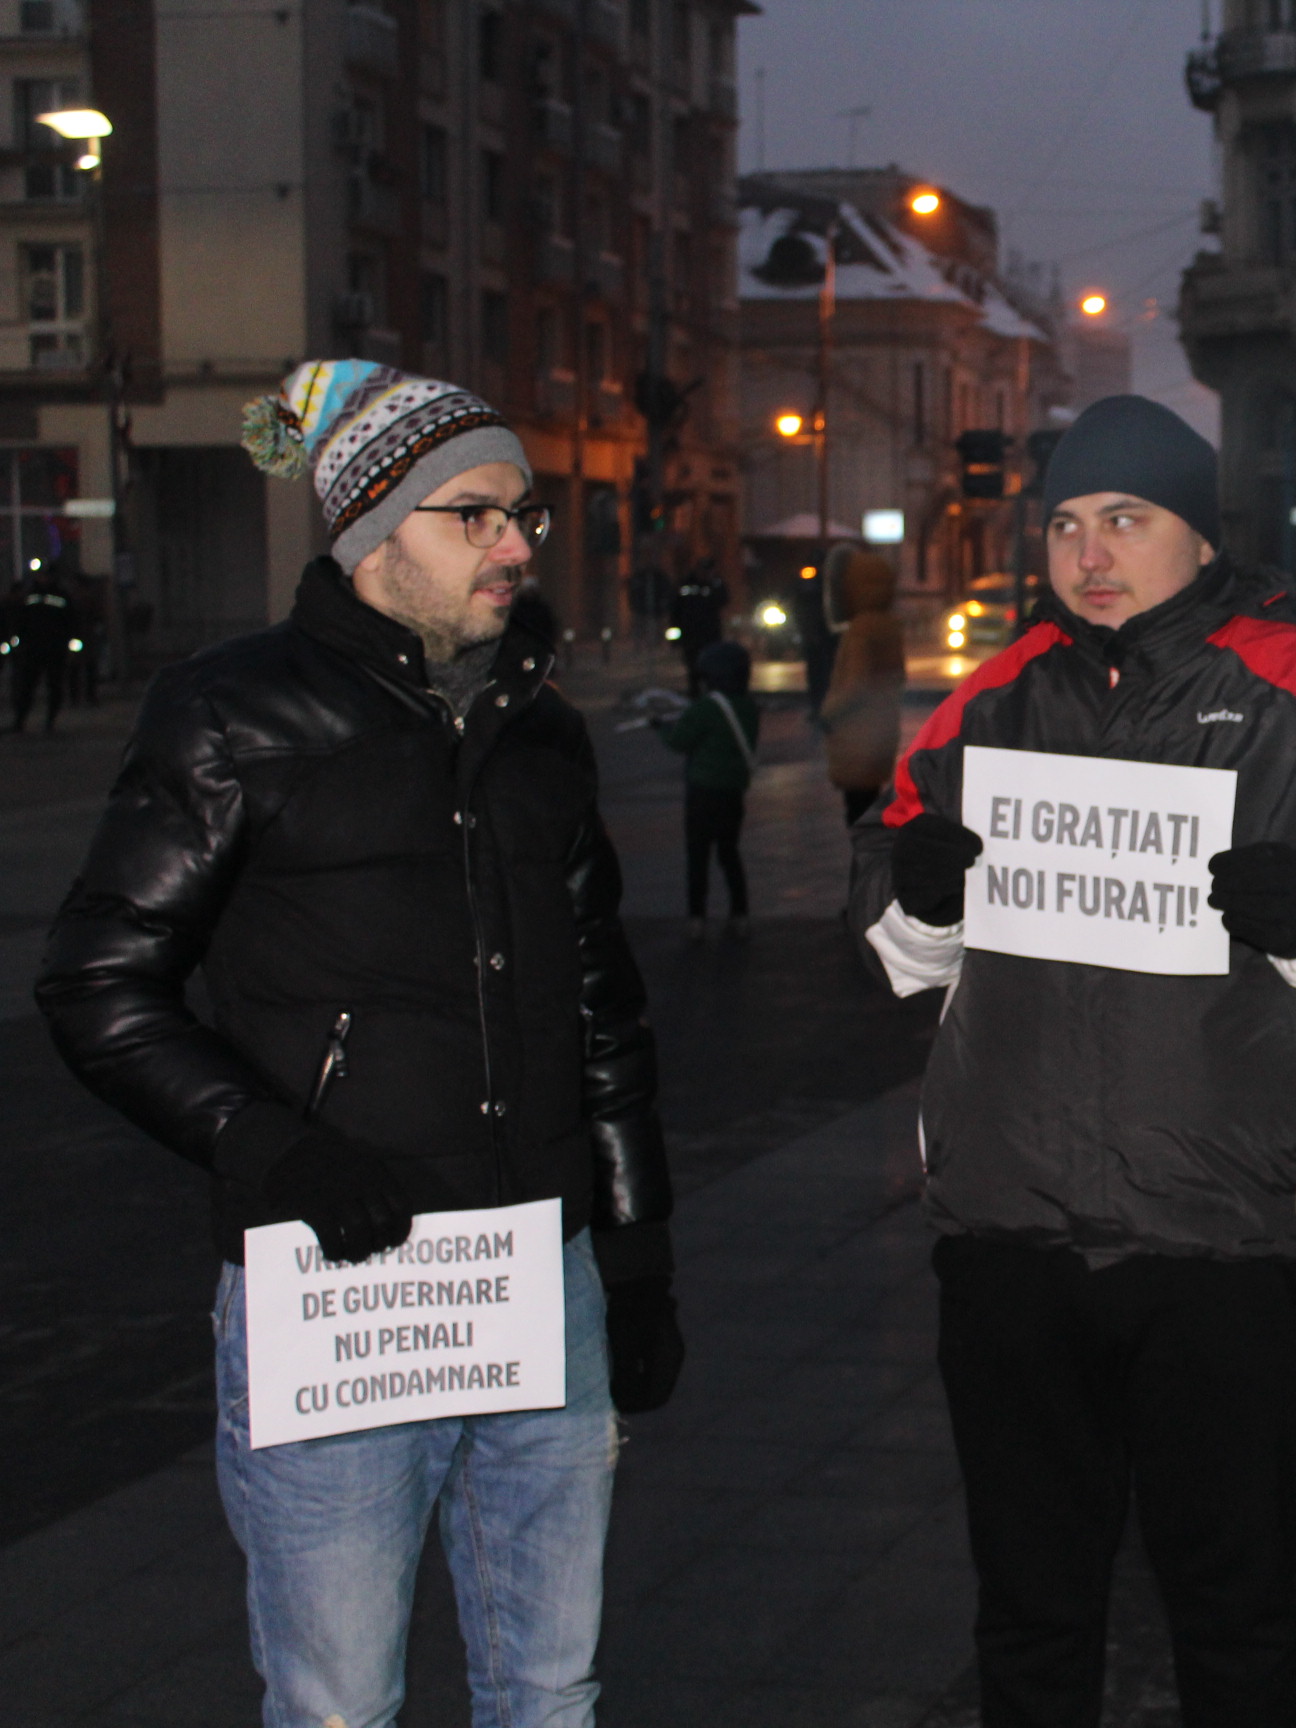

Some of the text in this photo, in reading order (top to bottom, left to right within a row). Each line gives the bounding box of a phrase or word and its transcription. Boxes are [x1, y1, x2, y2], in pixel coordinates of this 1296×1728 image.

[990, 796, 1022, 840] EI
[987, 865, 1199, 933] NOI FURAȚI!
[302, 1276, 510, 1321] DE GUVERNARE
[334, 1321, 474, 1362] NU PENALI
[295, 1361, 521, 1414] CU CONDAMNARE
